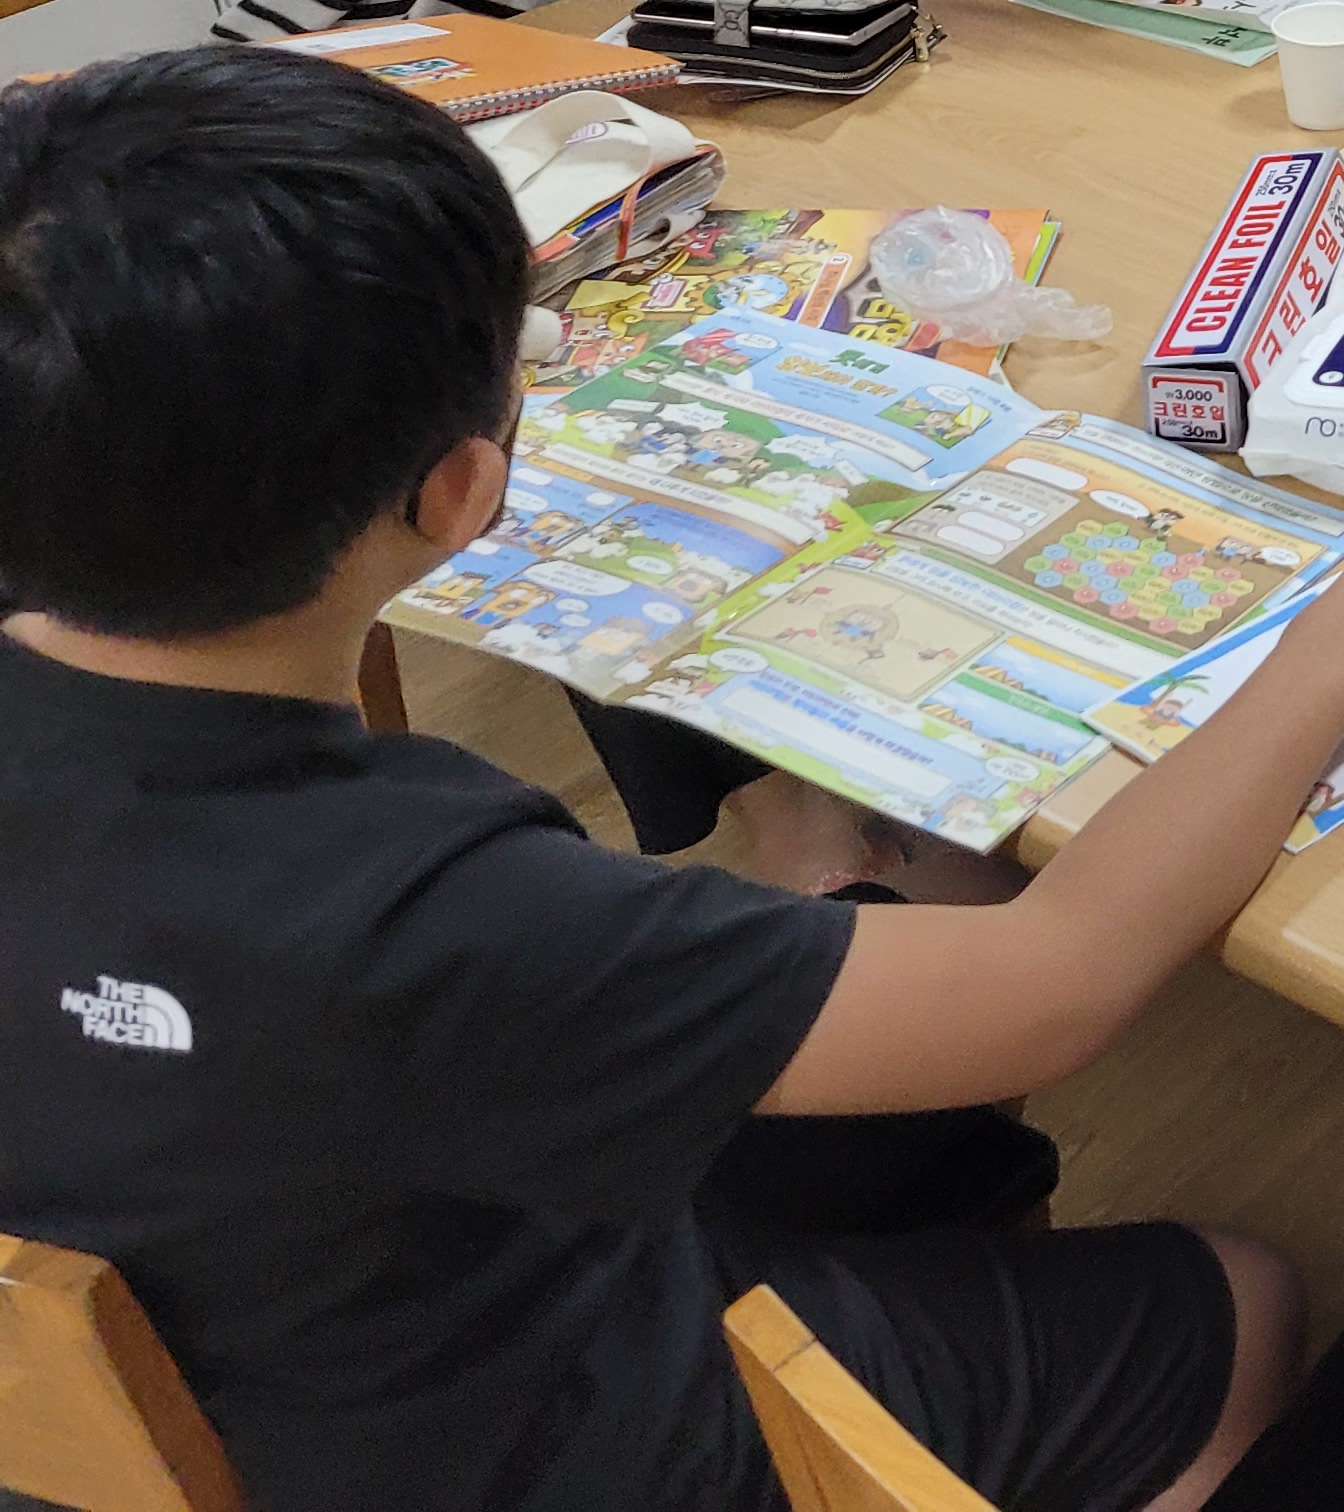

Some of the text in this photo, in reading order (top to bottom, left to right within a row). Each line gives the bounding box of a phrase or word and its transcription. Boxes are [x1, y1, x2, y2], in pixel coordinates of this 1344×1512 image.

[1268, 160, 1306, 196] 30m
[1185, 199, 1287, 334] CLEAN FOIL
[1153, 401, 1225, 421] 크린호일
[1182, 424, 1219, 439] 30m
[97, 975, 144, 1000] THE
[60, 987, 144, 1026] NORTH
[82, 1014, 146, 1046] FACE
